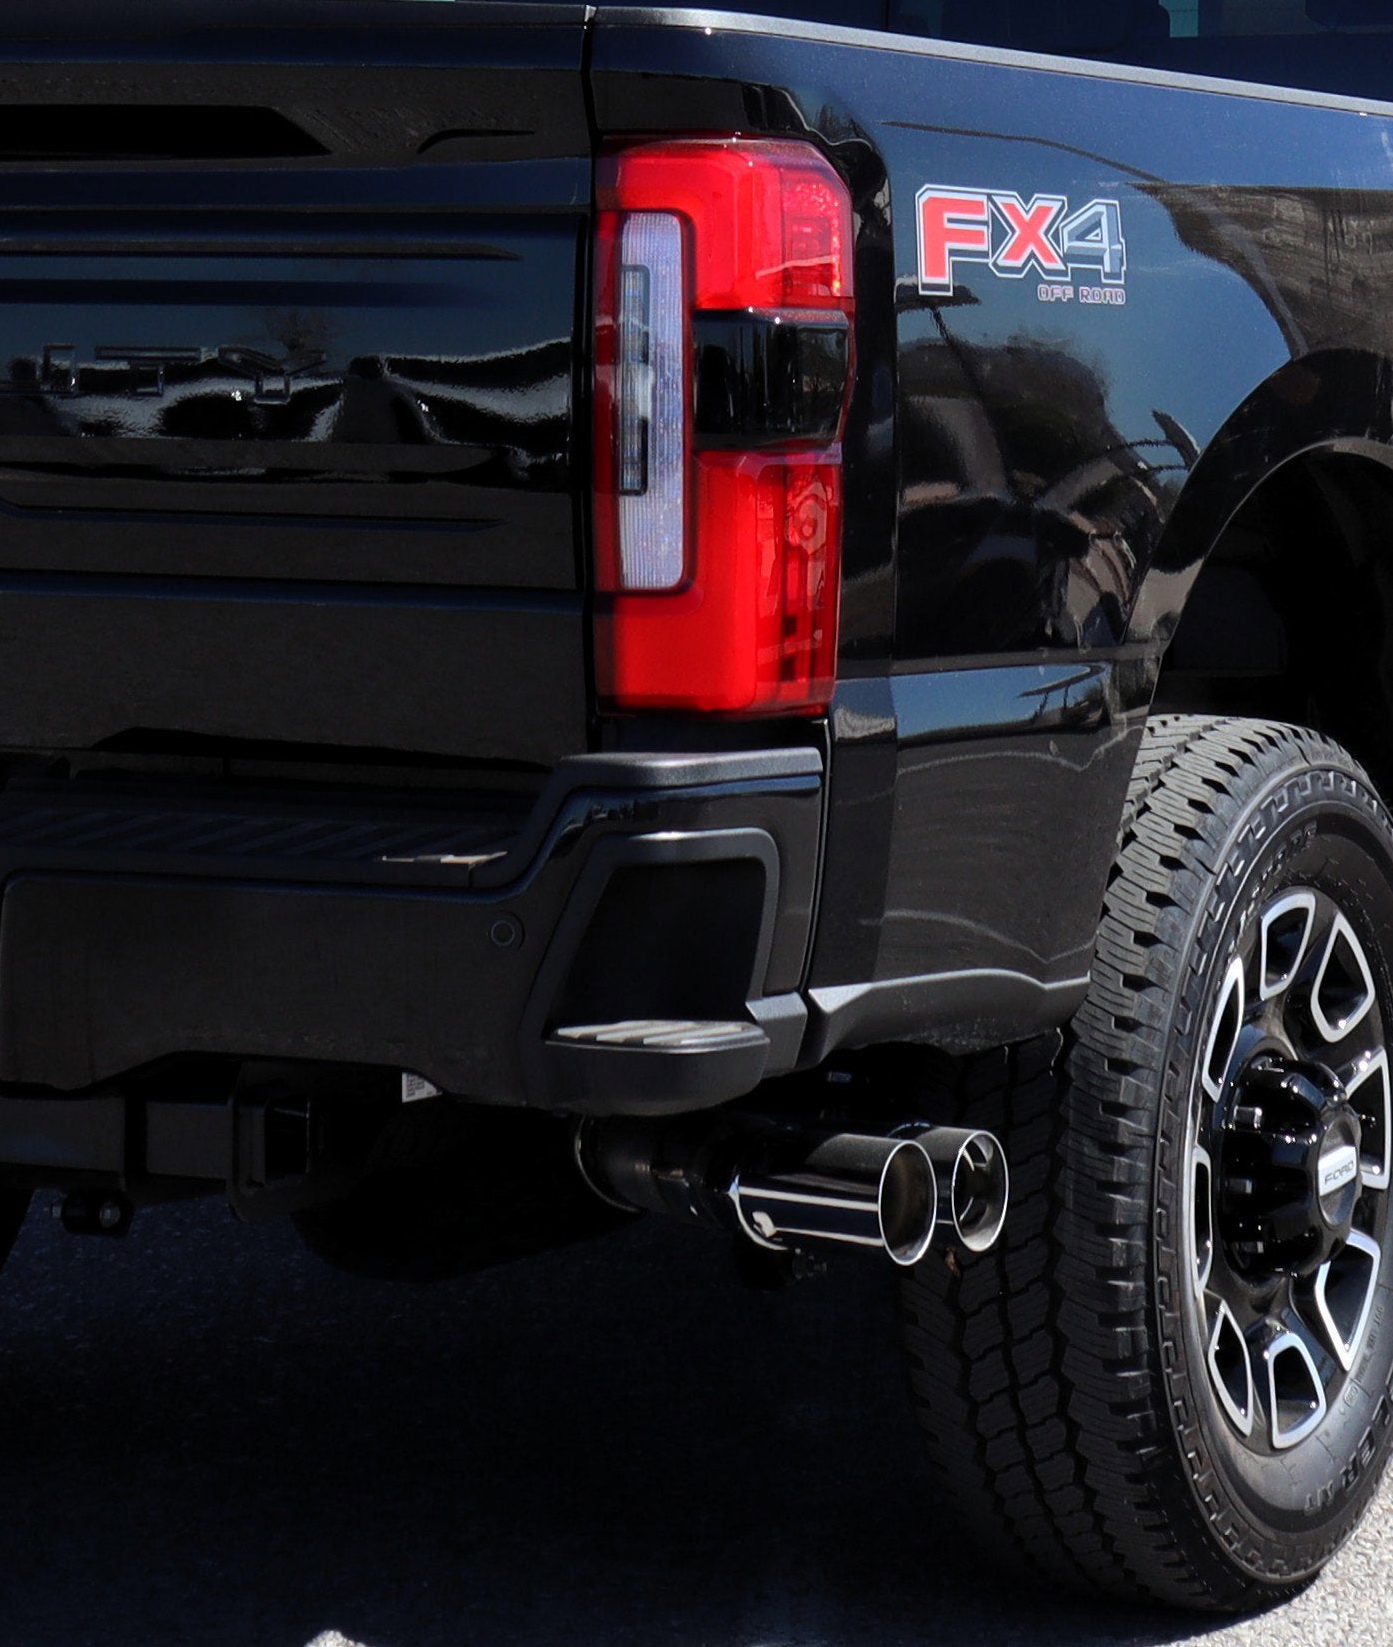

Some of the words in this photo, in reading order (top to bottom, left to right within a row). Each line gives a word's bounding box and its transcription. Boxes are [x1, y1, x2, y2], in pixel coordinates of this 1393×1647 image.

[915, 183, 1127, 297] FX4
[1037, 284, 1074, 302] OFF
[1079, 286, 1126, 305] ROAD
[1324, 1159, 1355, 1186] FORD
